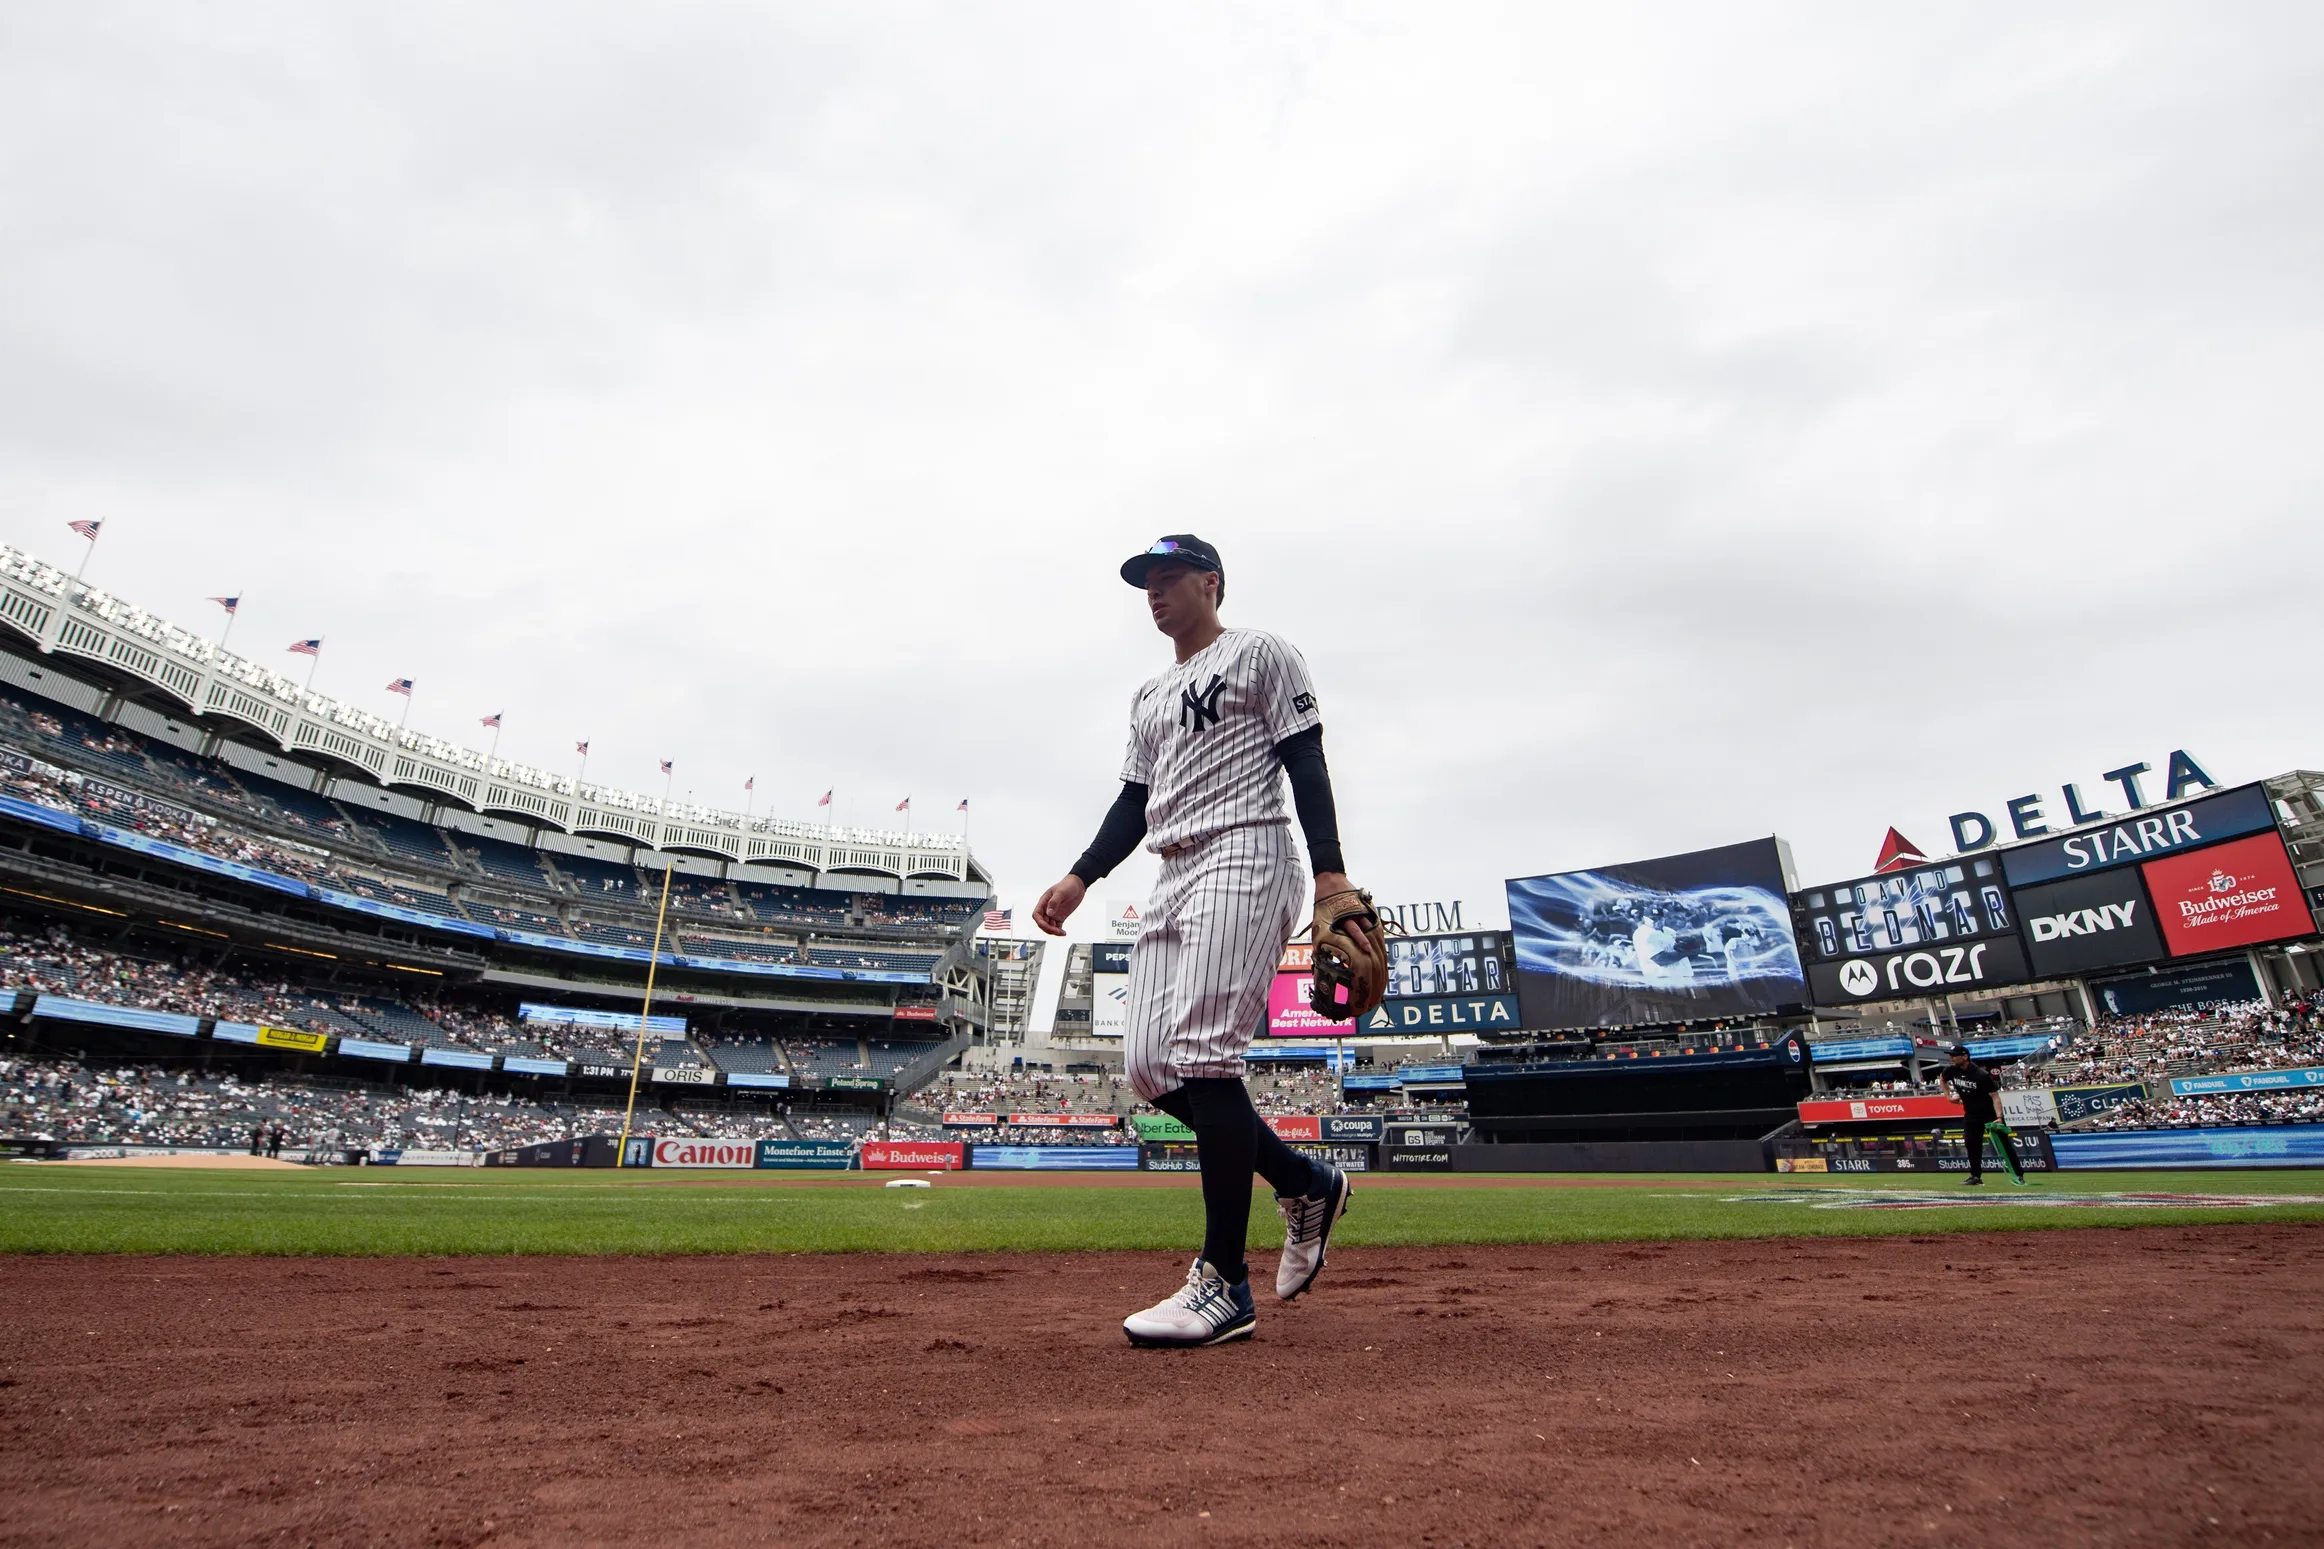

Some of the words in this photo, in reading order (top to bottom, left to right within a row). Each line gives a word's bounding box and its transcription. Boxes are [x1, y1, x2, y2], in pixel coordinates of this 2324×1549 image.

[1180, 674, 1227, 732] NY
[87, 781, 132, 803] ASPEN
[1949, 749, 2217, 852] DELTA
[147, 801, 188, 821] VODKA
[2063, 809, 2201, 869] STARR
[1857, 871, 1946, 905] DAVID
[2178, 887, 2276, 916] Budweiser
[2030, 900, 2136, 942] DKNY
[2184, 913, 2218, 928] Made
[2220, 910, 2231, 922] of
[2230, 903, 2279, 920] America
[1818, 889, 2010, 956] BEDNAR
[1393, 940, 1463, 959] DAVID
[1886, 943, 1986, 990] razr
[1404, 1001, 1510, 1025] DELTA
[1272, 1019, 1298, 1028] Best
[583, 1065, 599, 1076] 1:31
[600, 1066, 615, 1077] PM
[664, 1069, 703, 1082] ORIS
[831, 1077, 855, 1088] Poland
[855, 1078, 878, 1089] Spring
[2193, 1081, 2227, 1089] FANDUEL
[2253, 1075, 2290, 1084] FANDUEL
[1868, 1104, 1905, 1114] TOYOTA
[1136, 1122, 1162, 1133] Uber
[1165, 1122, 1192, 1134] Eats
[1344, 1121, 1373, 1132] coupa
[1407, 1135, 1421, 1144] GS
[655, 1141, 753, 1164] Canon
[764, 1145, 815, 1156] Montefiore
[816, 1146, 853, 1156] Einsten
[889, 1150, 958, 1163] Budweisr
[1392, 1153, 1449, 1163] NITTOTIRE.COM
[1835, 1159, 1870, 1170] STARR
[1149, 1161, 1183, 1170] StubHub
